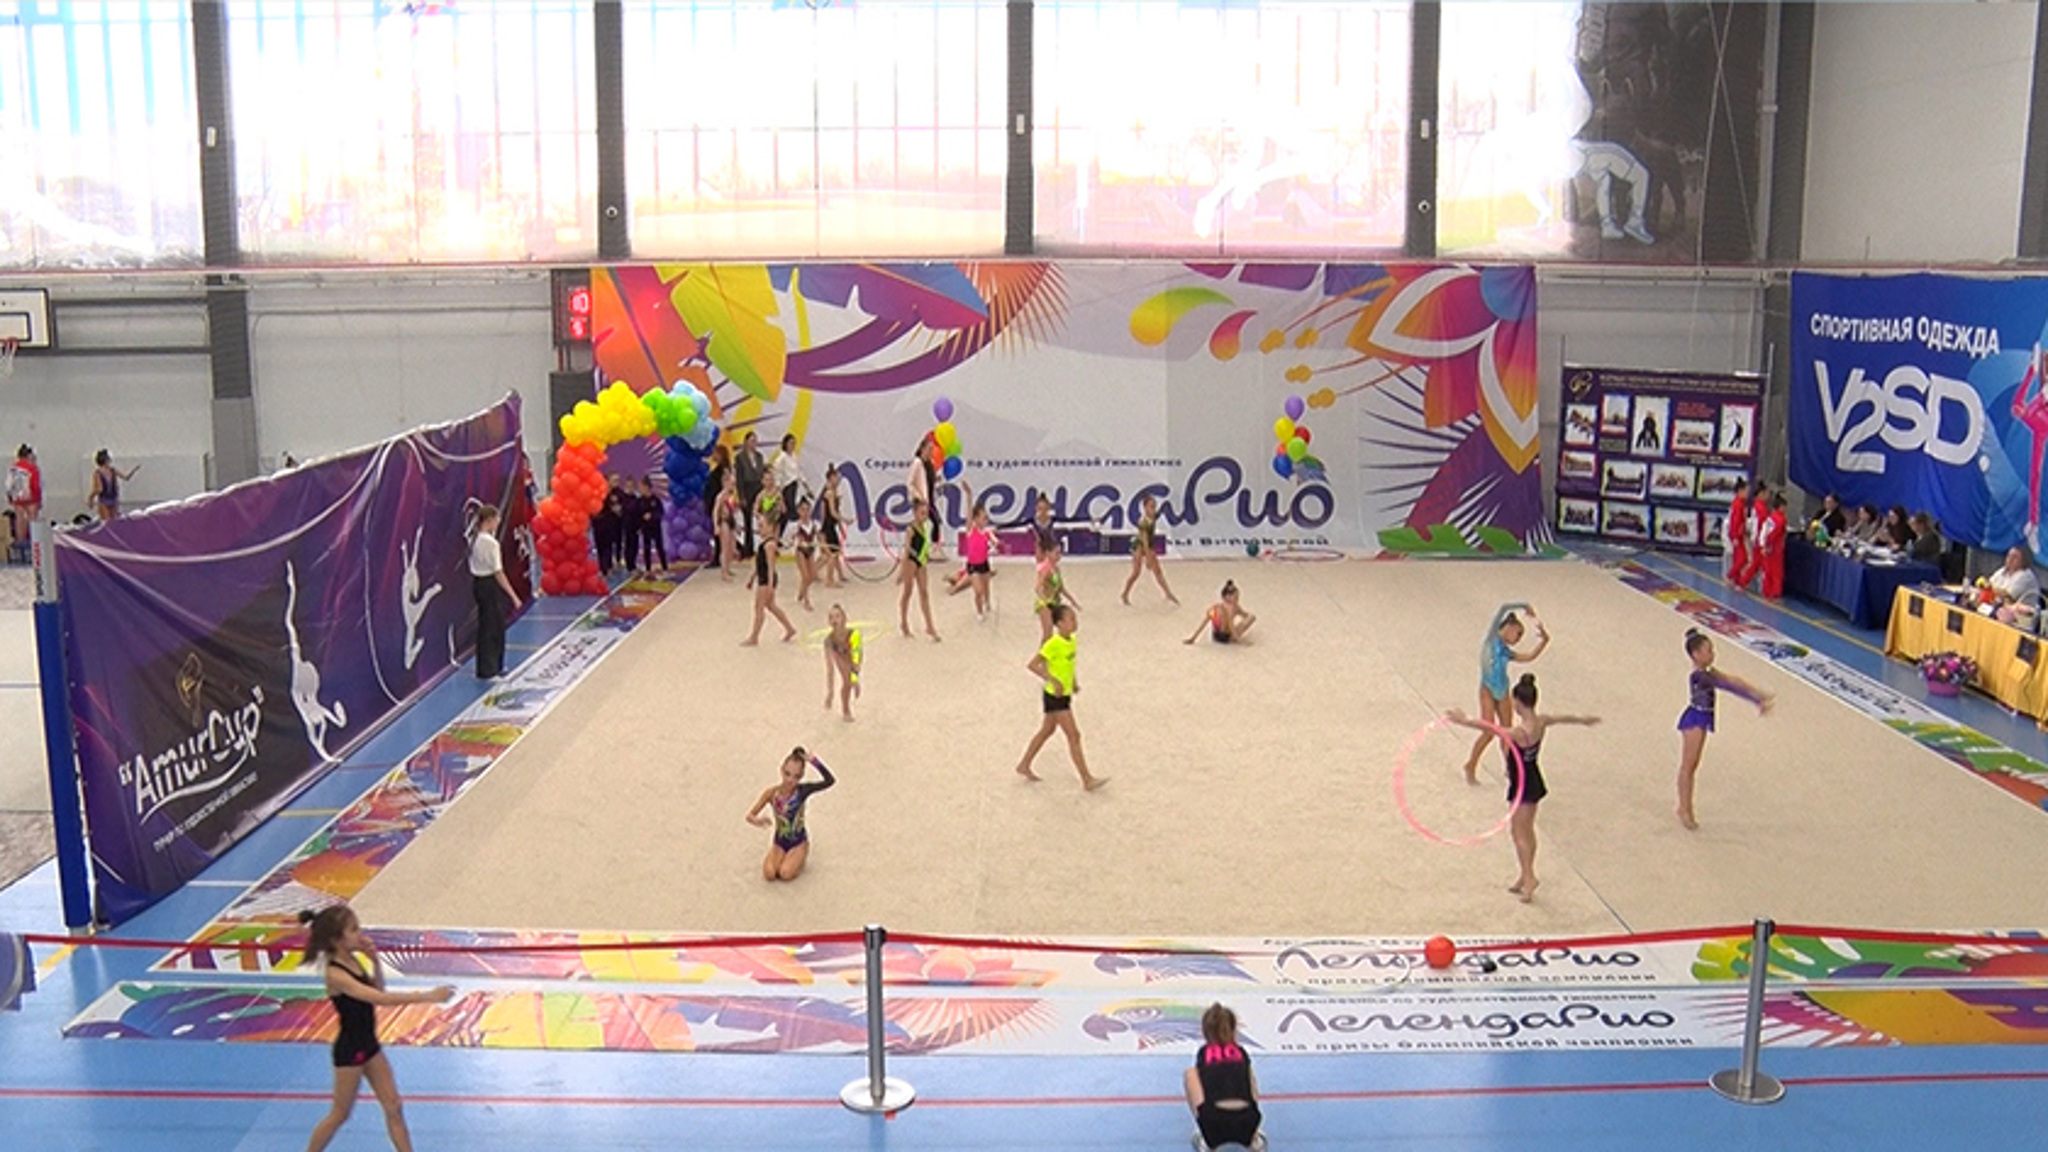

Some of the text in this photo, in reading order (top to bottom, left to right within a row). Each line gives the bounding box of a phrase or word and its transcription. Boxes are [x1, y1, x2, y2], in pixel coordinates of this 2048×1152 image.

[1811, 313, 2000, 358] СПОРТИВНАЯ ОДЕЖДА
[1277, 947, 1639, 974] ЛегедаРио
[1278, 1003, 1676, 1038] ЛегендаРио
